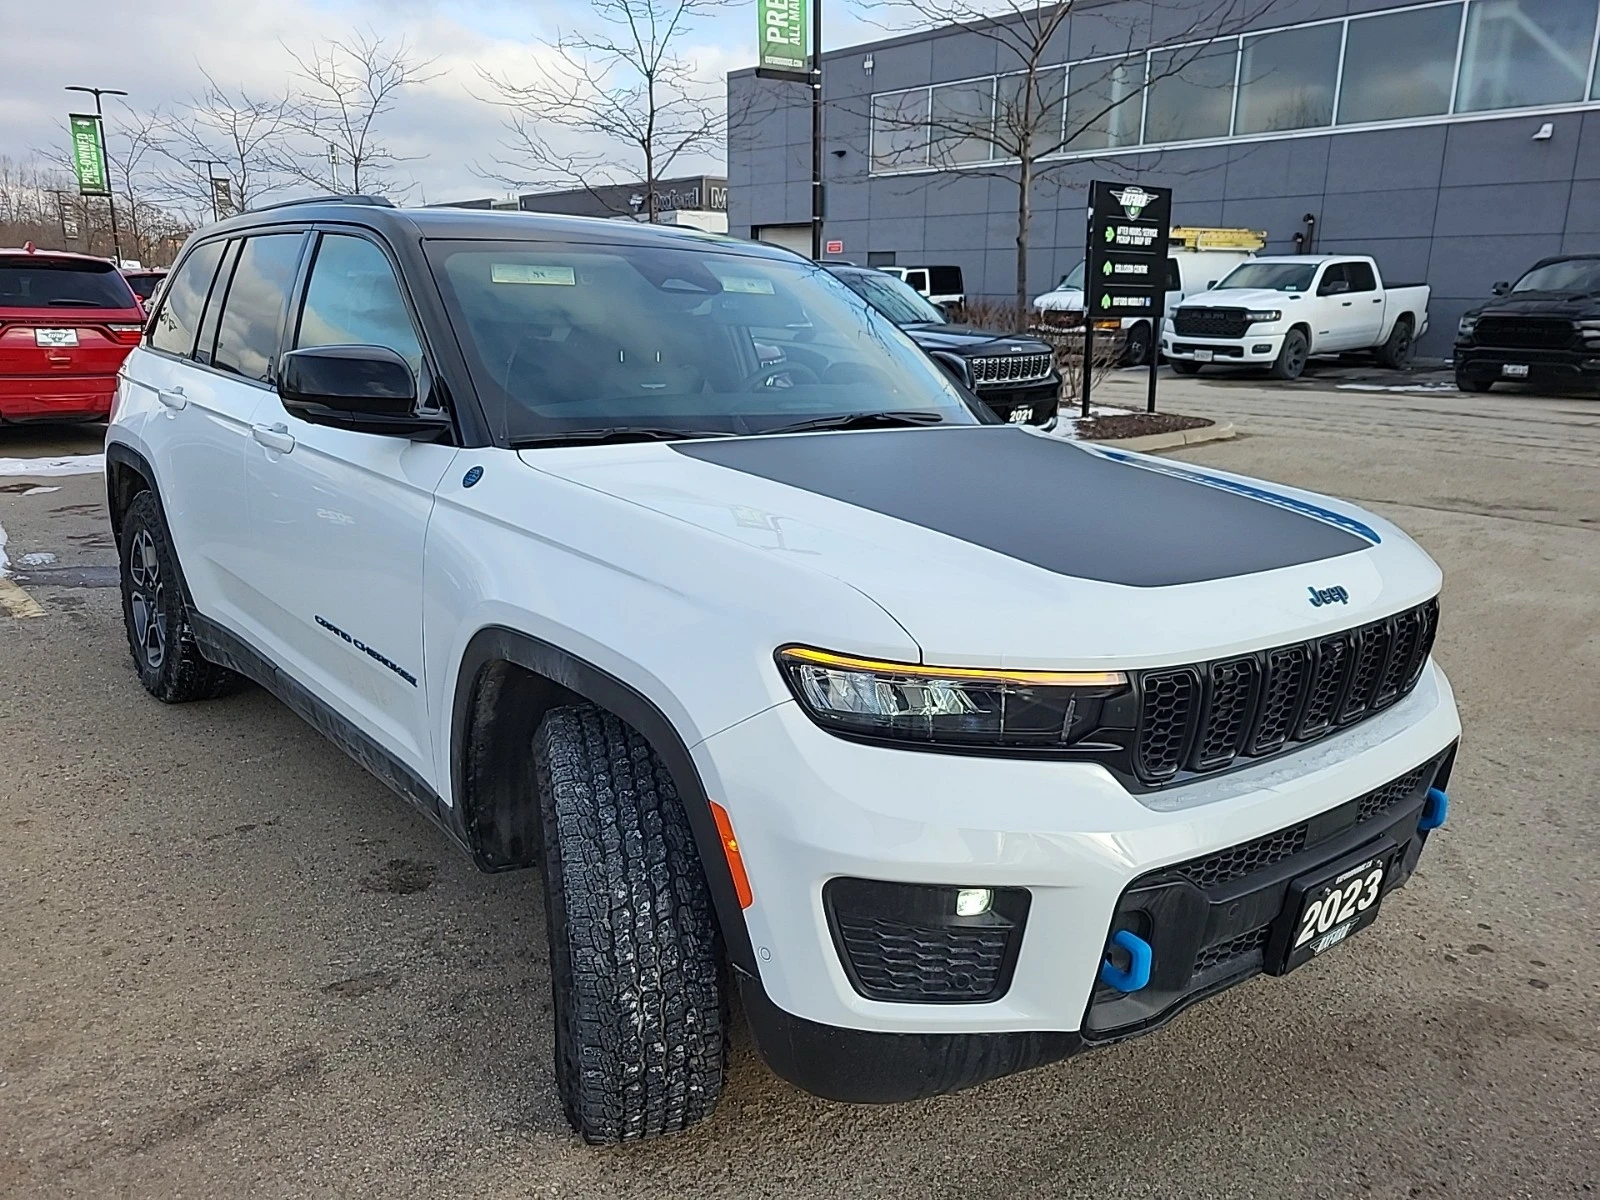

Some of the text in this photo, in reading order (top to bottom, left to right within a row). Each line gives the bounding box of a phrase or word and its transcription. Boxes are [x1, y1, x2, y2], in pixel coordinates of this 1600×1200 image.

[789, 24, 801, 46] ALL
[76, 133, 94, 184] PRE-OWNED
[1009, 408, 1034, 422] 2021
[1307, 585, 1350, 607] Jeep
[314, 615, 418, 688] GRAND CHEROKEE
[1295, 868, 1383, 948] 2023
